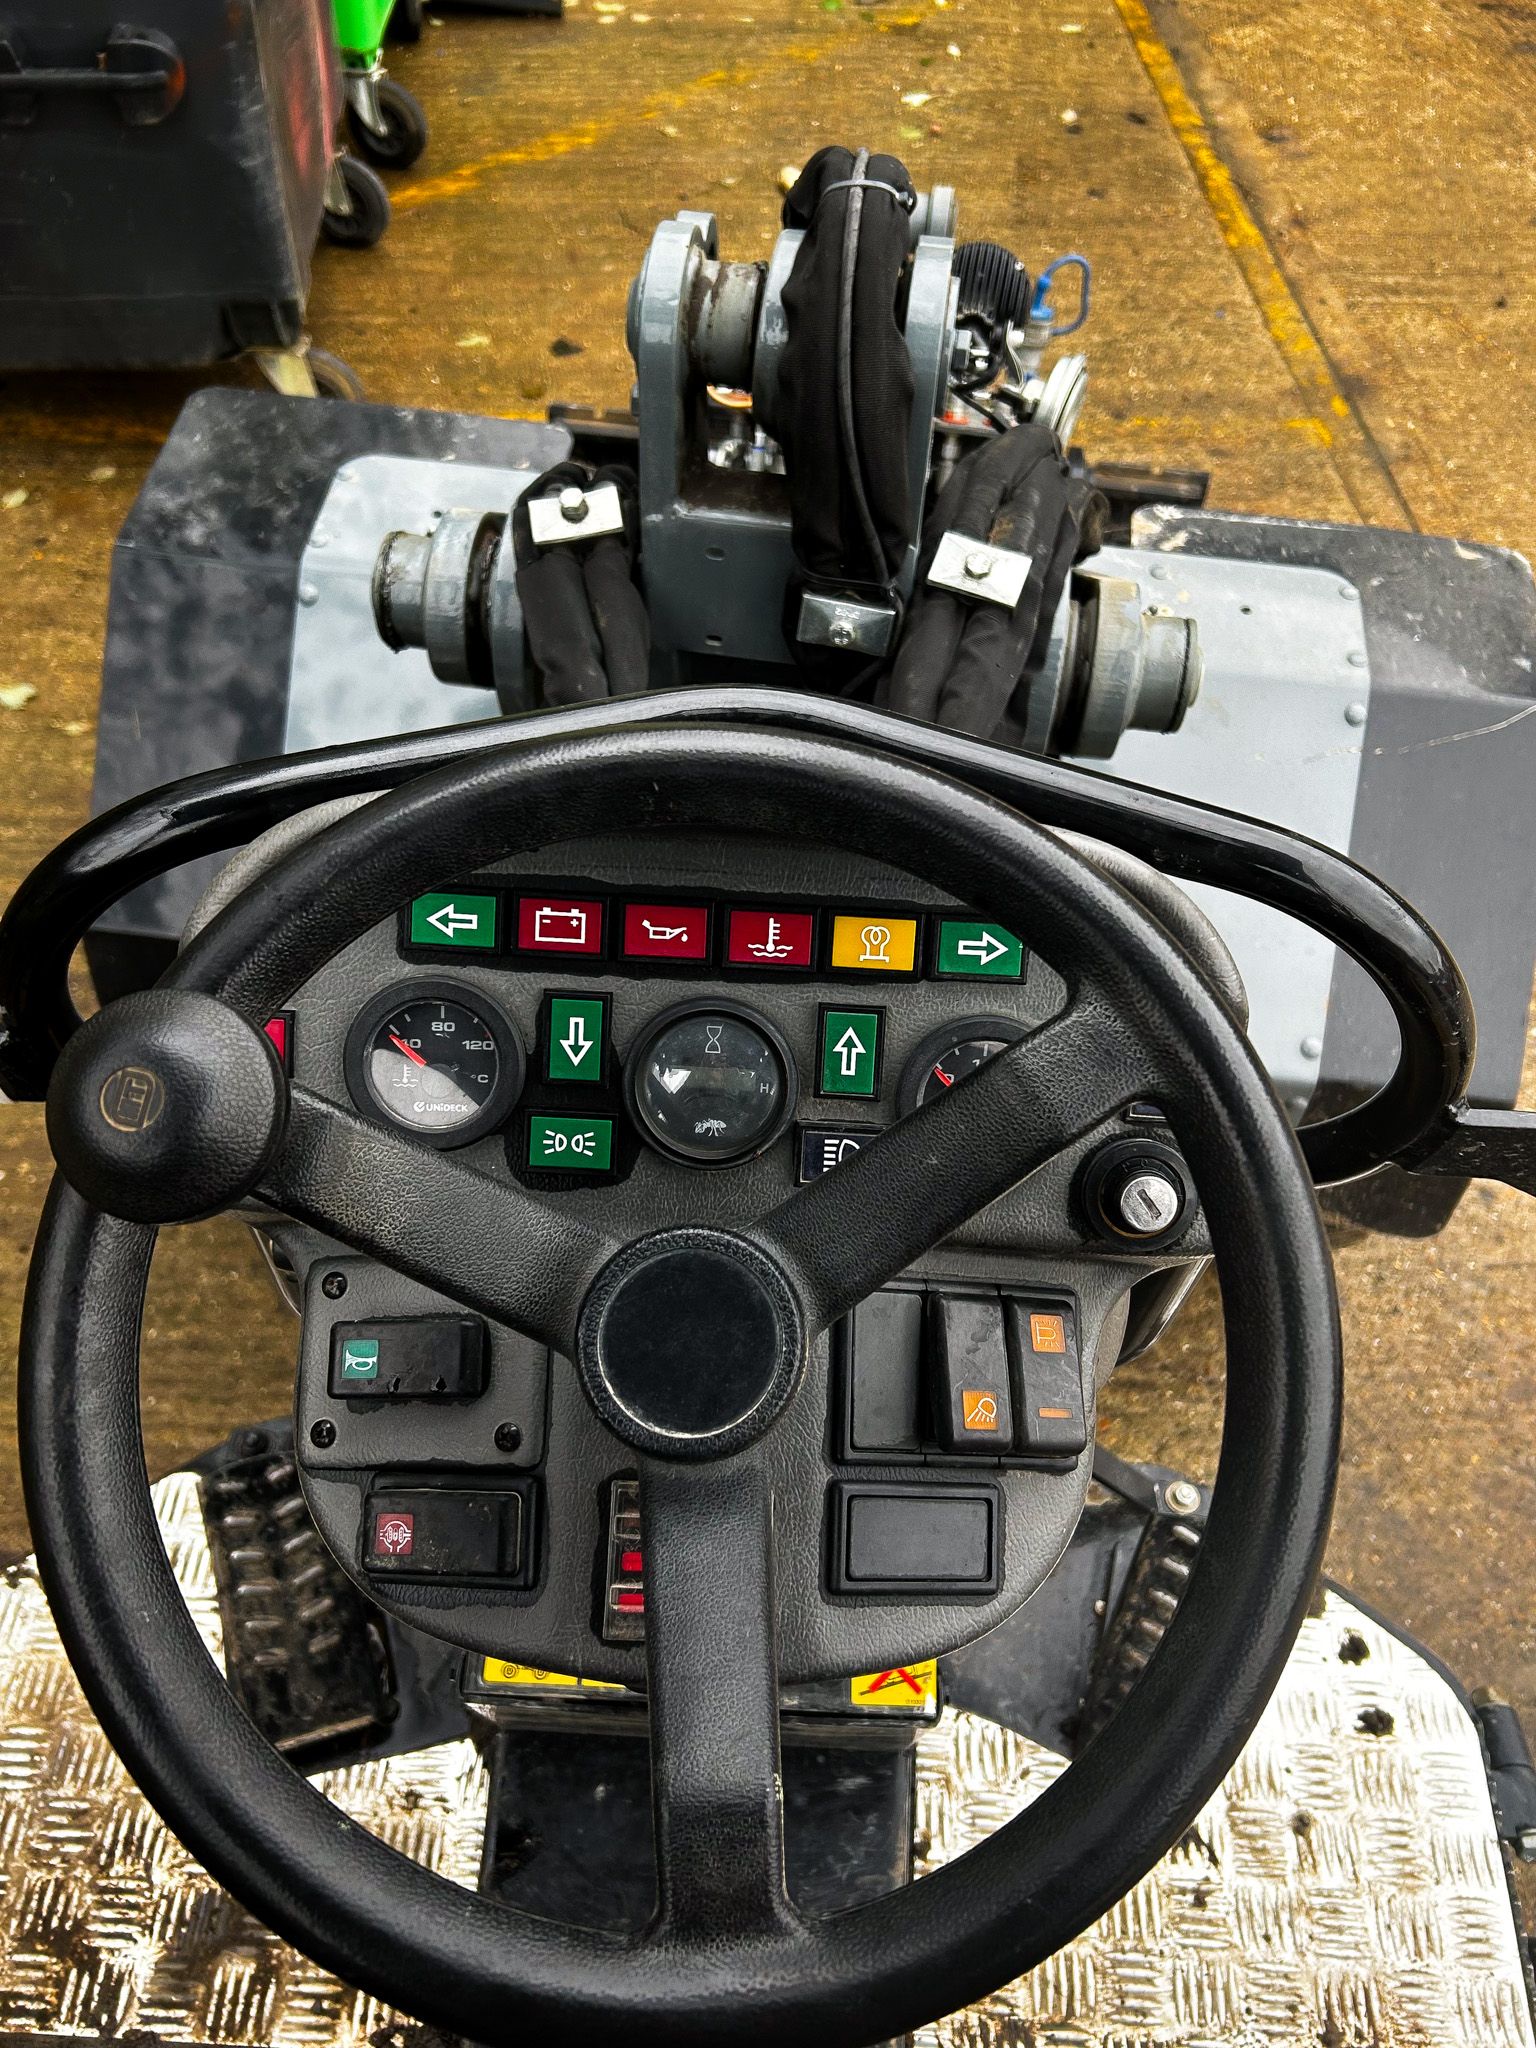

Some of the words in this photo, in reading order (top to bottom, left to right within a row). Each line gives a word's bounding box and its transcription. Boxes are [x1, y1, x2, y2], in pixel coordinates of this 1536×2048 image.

[431, 1021, 456, 1032] 80
[461, 1040, 495, 1051] 120
[759, 1082, 769, 1094] H
